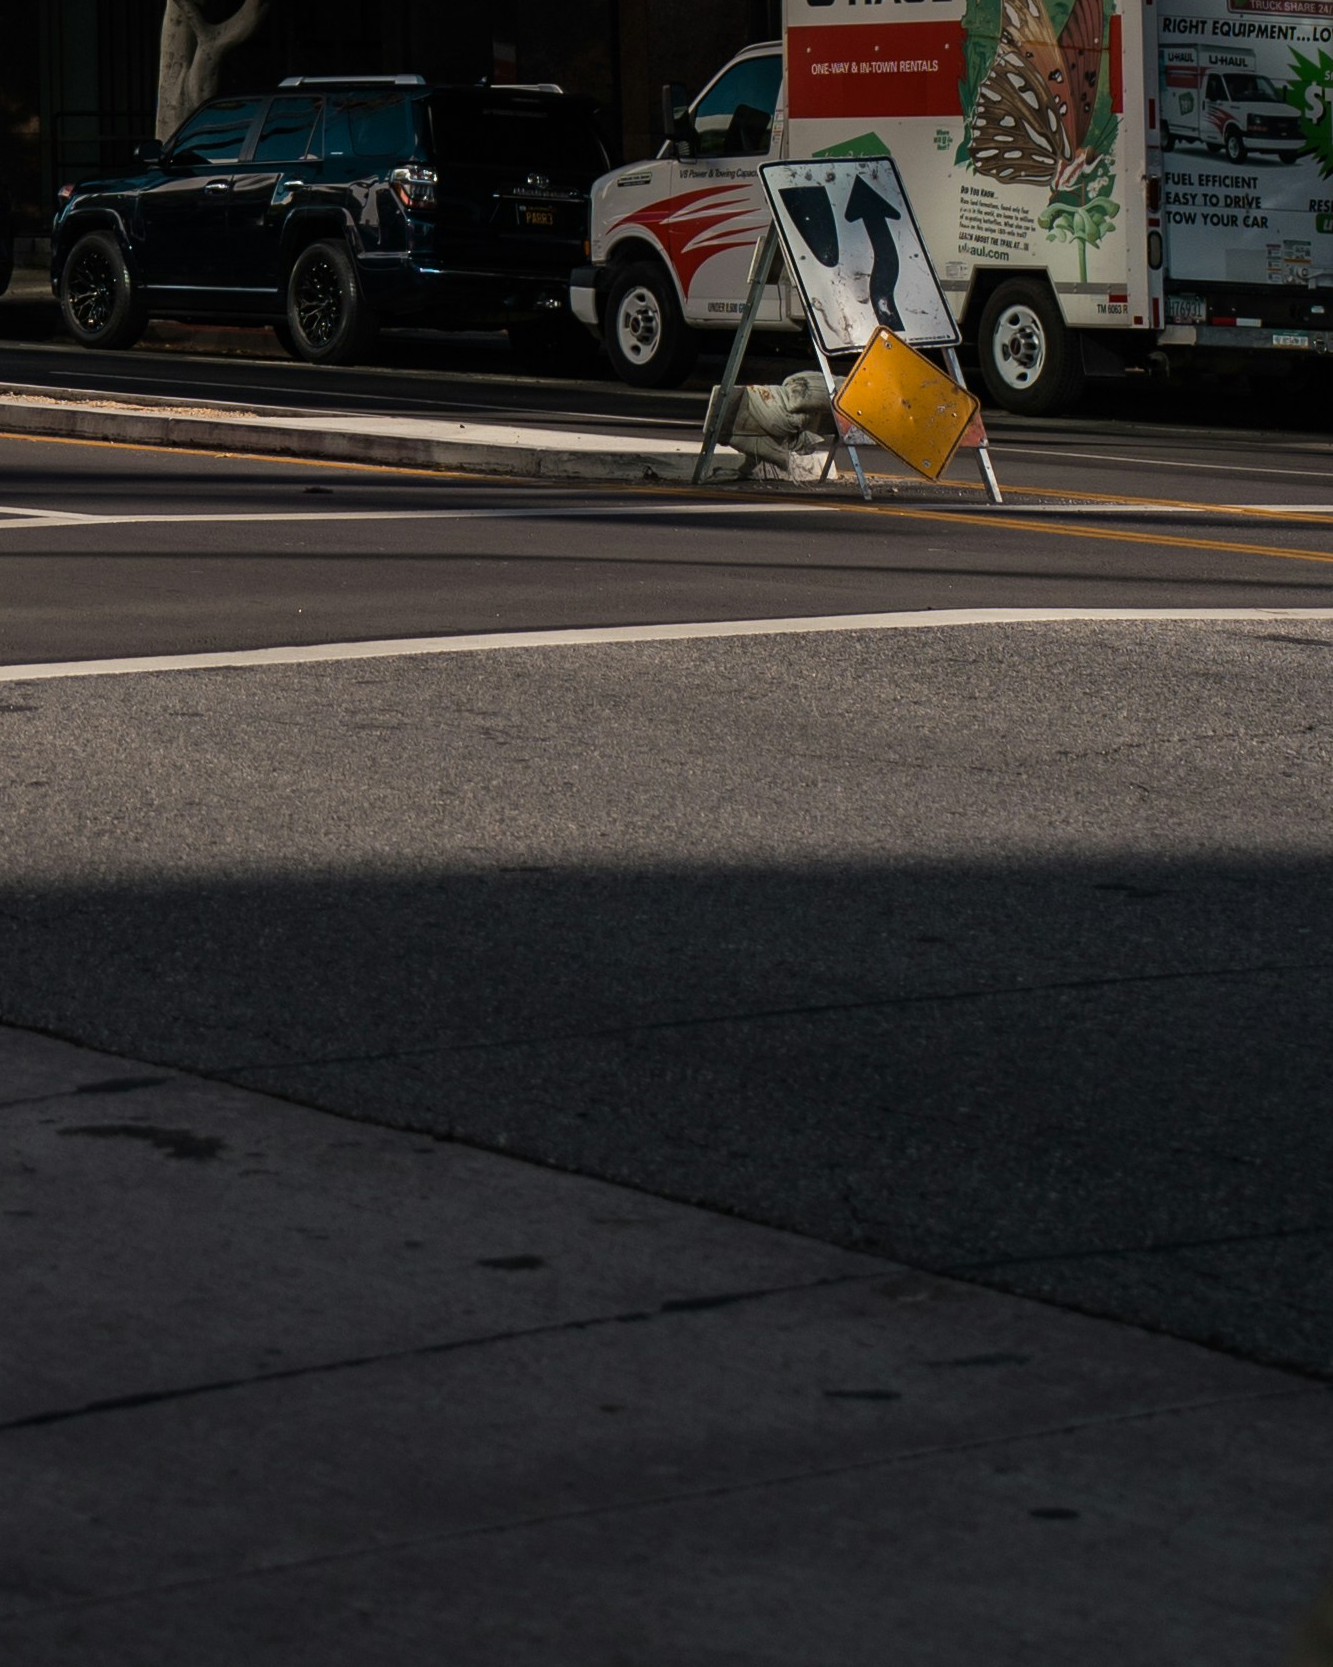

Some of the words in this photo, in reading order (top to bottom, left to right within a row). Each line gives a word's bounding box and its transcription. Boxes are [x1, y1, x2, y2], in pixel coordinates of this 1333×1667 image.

[1250, 0, 1281, 10] TRUCK
[1284, 1, 1316, 12] SHARE
[1163, 17, 1207, 35] RIGHT
[811, 61, 849, 75] ONE-WAY
[851, 61, 858, 74] &
[859, 60, 897, 74] IN-TOWN
[899, 60, 938, 73] RENTALS
[1209, 55, 1248, 68] U-HAUL
[688, 170, 707, 178] Power
[708, 170, 714, 178] &
[714, 169, 735, 179] Towing
[1165, 172, 1194, 186] FUEL
[1198, 174, 1258, 189] EFFICIENT
[1165, 191, 1198, 205] EASY
[1202, 193, 1220, 206] TO
[1224, 195, 1262, 209] DRIVE
[1165, 211, 1197, 224] TOW
[1201, 212, 1238, 227] YOUR
[1243, 214, 1269, 229] CAR
[1097, 304, 1107, 313] TM
[1108, 304, 1122, 314] 6063
